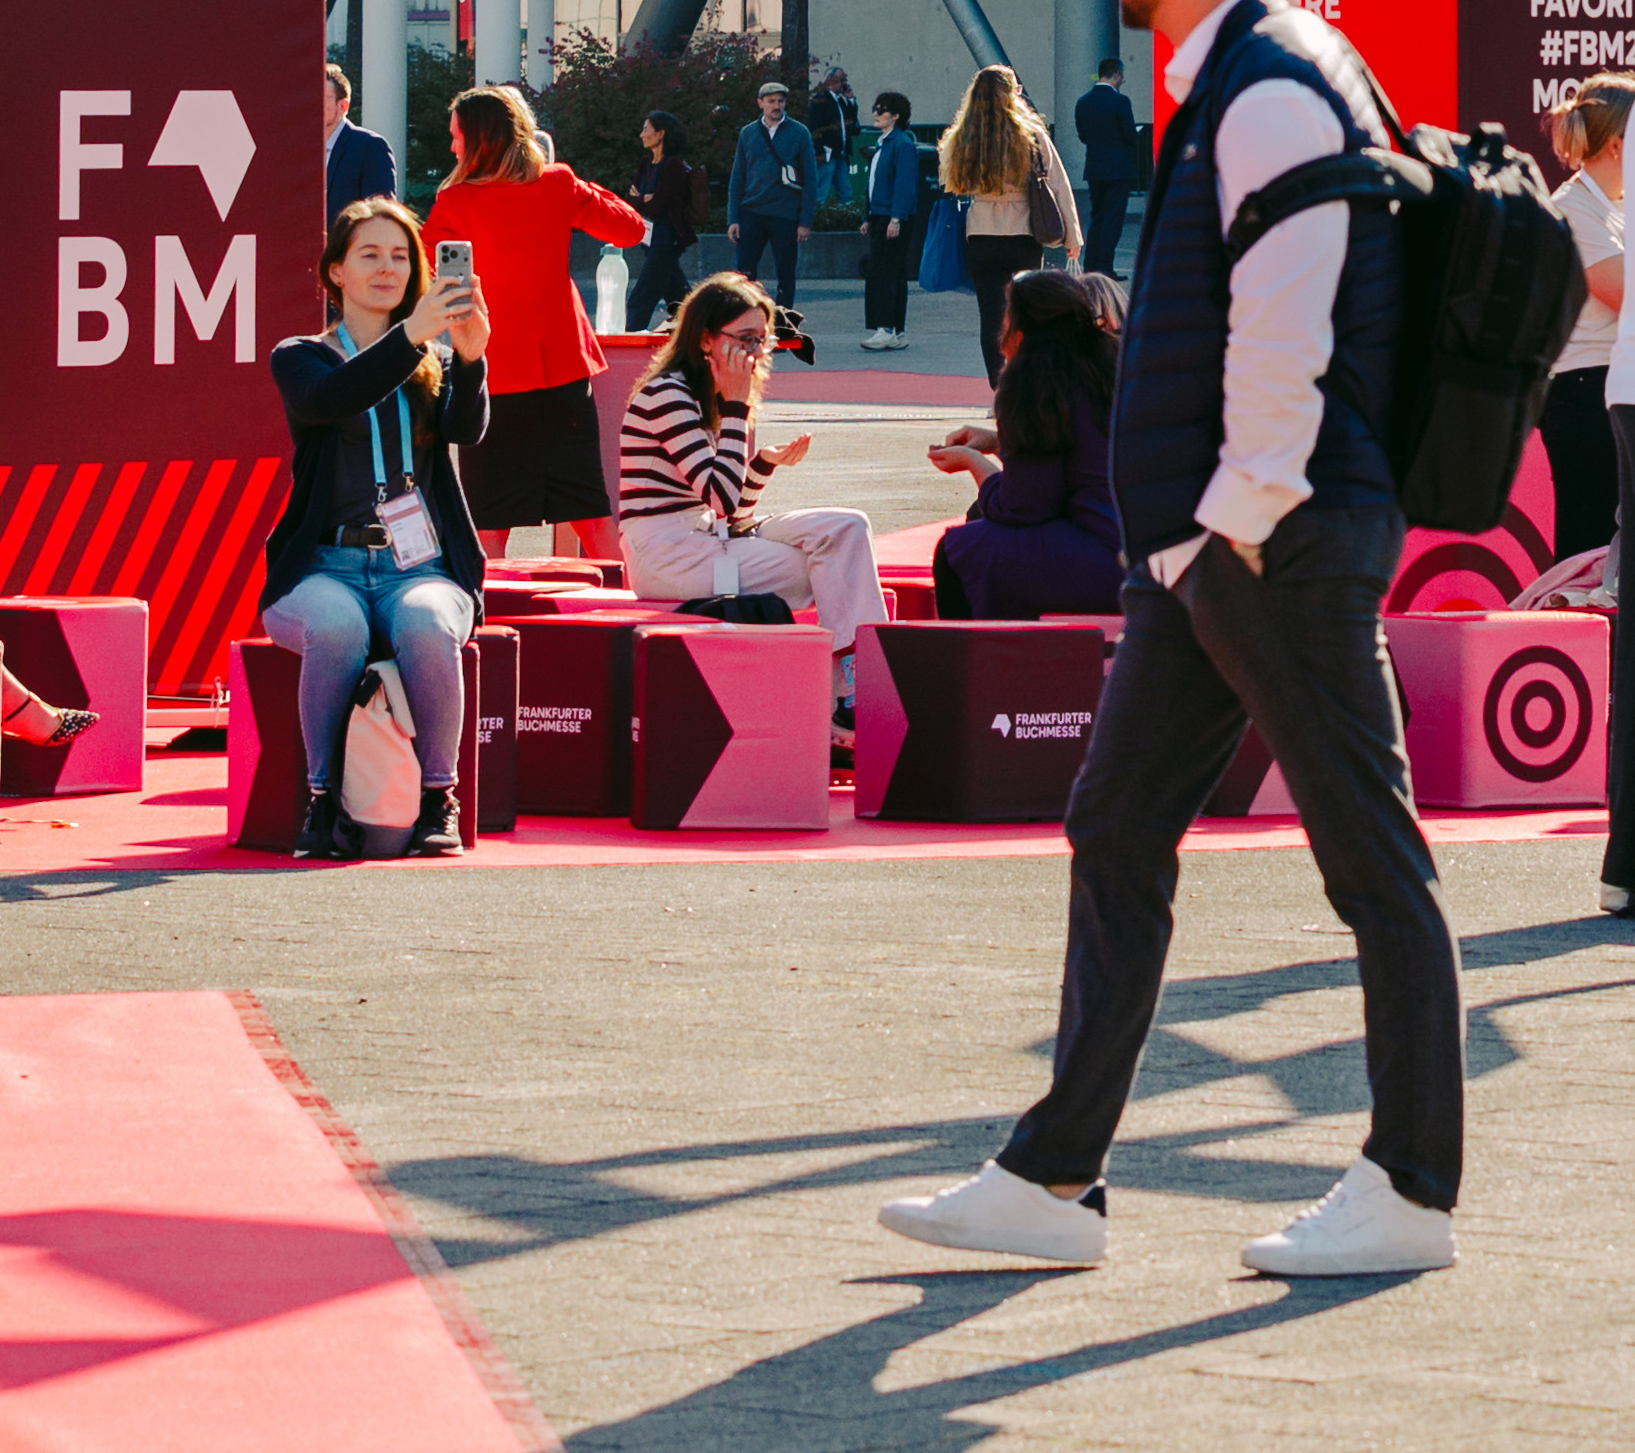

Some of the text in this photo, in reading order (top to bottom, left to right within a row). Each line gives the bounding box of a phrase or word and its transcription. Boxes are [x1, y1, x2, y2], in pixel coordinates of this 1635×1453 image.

[56, 233, 257, 369] BM
[518, 706, 592, 721] FRANKFURTER
[1016, 712, 1092, 725] FRANKFURTER
[518, 720, 582, 734] BUCHMESSE
[1016, 725, 1082, 739] BUCHMESSE
